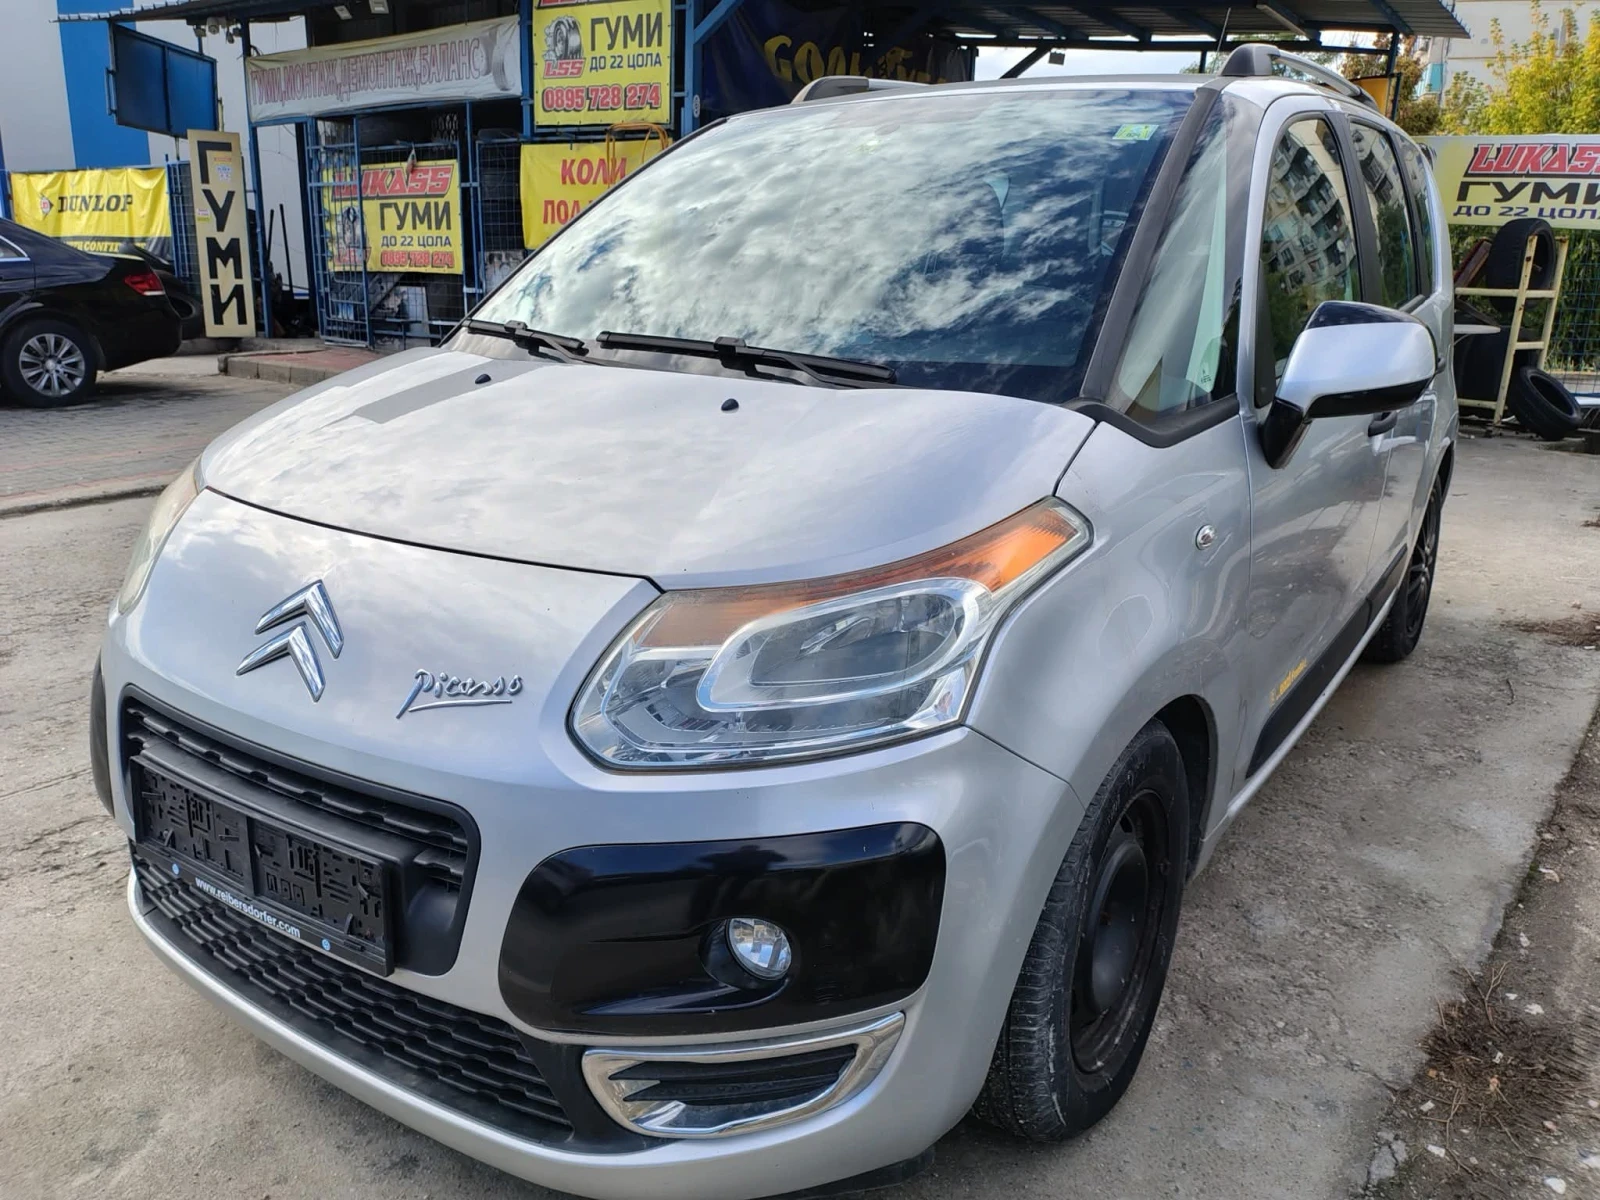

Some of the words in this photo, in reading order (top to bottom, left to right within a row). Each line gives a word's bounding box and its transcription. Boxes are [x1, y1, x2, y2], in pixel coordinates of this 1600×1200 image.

[590, 12, 663, 51] ГУМИ
[543, 58, 585, 79] LSS
[590, 56, 607, 73] ДО
[610, 55, 624, 69] 22
[627, 52, 662, 70] ЦОЛА
[543, 85, 586, 112] 0895
[588, 84, 623, 110] 728
[625, 82, 662, 109] 274
[561, 157, 627, 185] КОЛИ
[1464, 143, 1600, 177] LUKAS
[58, 194, 133, 213] DUNLOP
[1453, 205, 1491, 216] ДО
[1498, 206, 1528, 217] 22
[1537, 207, 1600, 220] ЦОЛ
[379, 201, 452, 231] ГУМИ
[381, 235, 398, 248] ДО
[400, 235, 414, 247] 22
[418, 235, 452, 248] ЦОЛА
